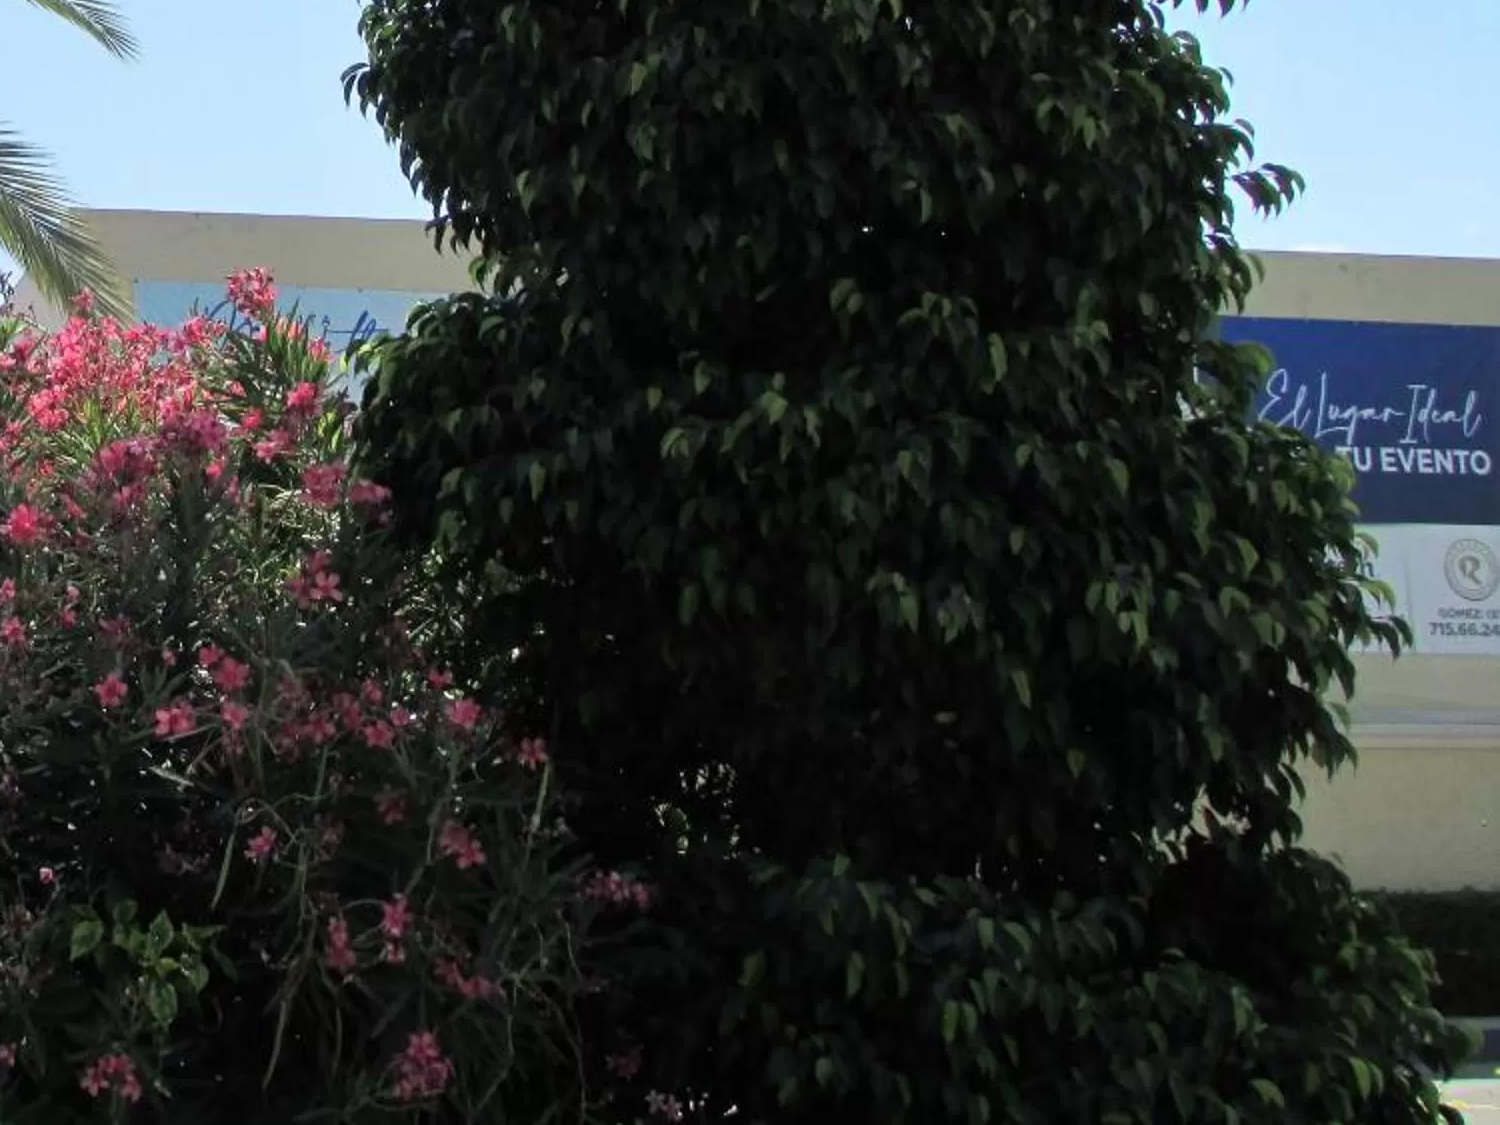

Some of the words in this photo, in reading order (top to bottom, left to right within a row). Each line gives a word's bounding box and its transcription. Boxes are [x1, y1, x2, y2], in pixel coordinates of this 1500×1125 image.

[1314, 372, 1405, 445] Lugar
[1398, 383, 1482, 445] Ideal
[1379, 447, 1492, 476] EVENTO
